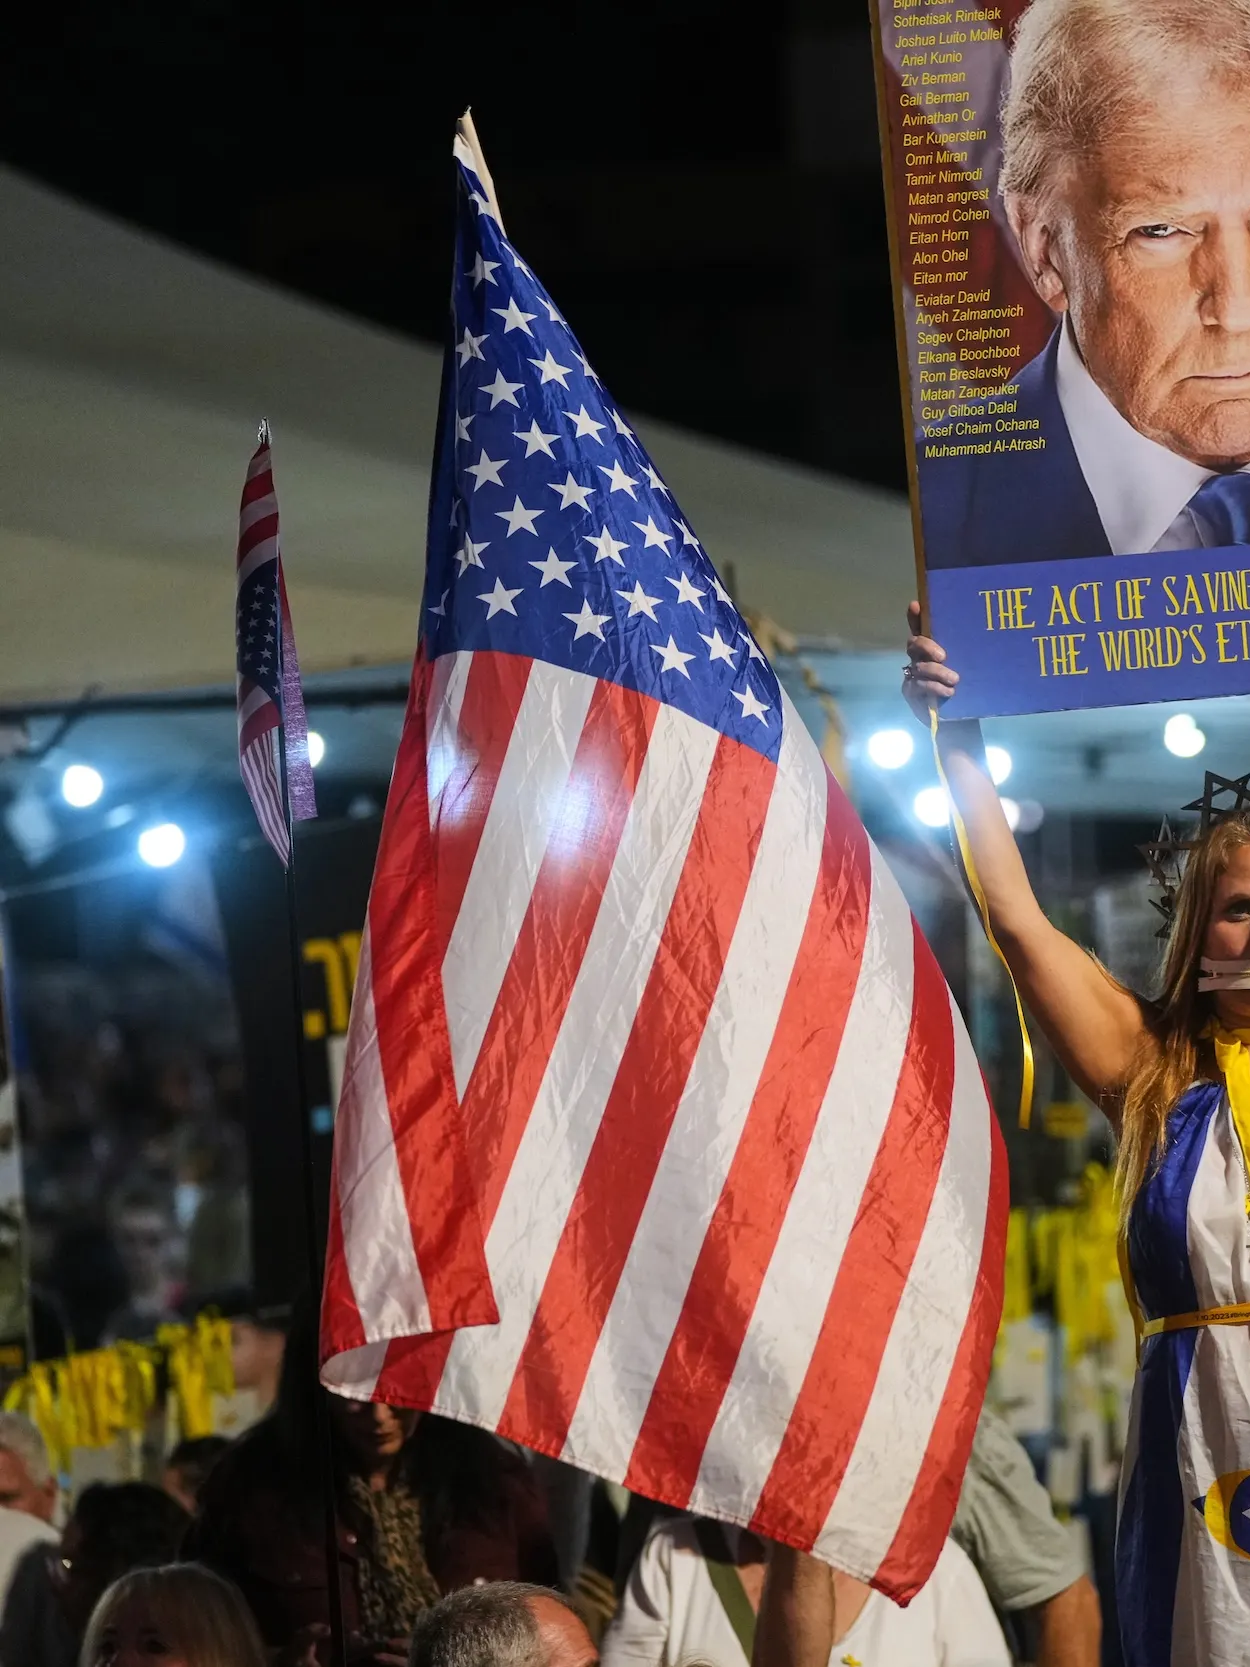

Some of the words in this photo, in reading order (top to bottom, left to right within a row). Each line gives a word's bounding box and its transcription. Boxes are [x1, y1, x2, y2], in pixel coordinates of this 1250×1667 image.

[894, 13, 951, 28] Sothetisak
[956, 7, 1001, 22] Rintelak
[895, 34, 935, 48] Joshua
[940, 31, 966, 44] Luito
[970, 28, 1003, 41] Mollel
[930, 50, 962, 64] Kunio
[902, 74, 918, 86] Ziv
[922, 72, 965, 85] Berman
[900, 93, 922, 107] Gali
[925, 91, 969, 105] Berman
[902, 111, 958, 126] Avinathan
[962, 109, 976, 121] Or
[903, 134, 924, 146] Bar
[926, 129, 986, 146] Kuperstein
[906, 152, 933, 166] Omri
[936, 150, 967, 163] Miran
[905, 172, 936, 186] Tamir
[939, 168, 982, 183] Nimrodi
[909, 191, 944, 205] Matan
[947, 188, 989, 205] angrest
[909, 210, 949, 225] Nimrod
[952, 208, 990, 222] Cohen
[910, 232, 938, 245] Eitan
[942, 229, 969, 242] Horn
[913, 252, 938, 265] Alon
[942, 248, 968, 262] Ohel
[914, 272, 942, 285] Eitan
[945, 271, 968, 282] mor
[915, 293, 955, 307] Eviatar
[958, 289, 990, 303] David
[916, 311, 948, 327] Aryeh
[952, 305, 1024, 322] Zalmanovich
[918, 332, 953, 346] Segev
[956, 327, 1010, 342] Chalphon
[918, 351, 956, 364] Elkana
[960, 345, 1020, 361] Boochboot
[920, 371, 946, 383] Rom
[950, 365, 1011, 381] Breslavsky
[921, 388, 955, 401] Matan
[959, 383, 1020, 399] Zangauker
[922, 407, 944, 421] Guy
[948, 404, 984, 417] Gilboa
[988, 400, 1017, 414] Dalal
[922, 424, 953, 438] Yosef
[956, 421, 991, 435] Chaim
[995, 419, 1039, 432] Ochana
[925, 441, 992, 458] Muhammad
[994, 437, 1046, 452] Al-Atrash
[978, 587, 1035, 631] THE
[1047, 582, 1103, 625] ACT
[1116, 577, 1151, 620] OF
[1032, 633, 1089, 677] THE
[1098, 623, 1206, 672] WORLD'S
